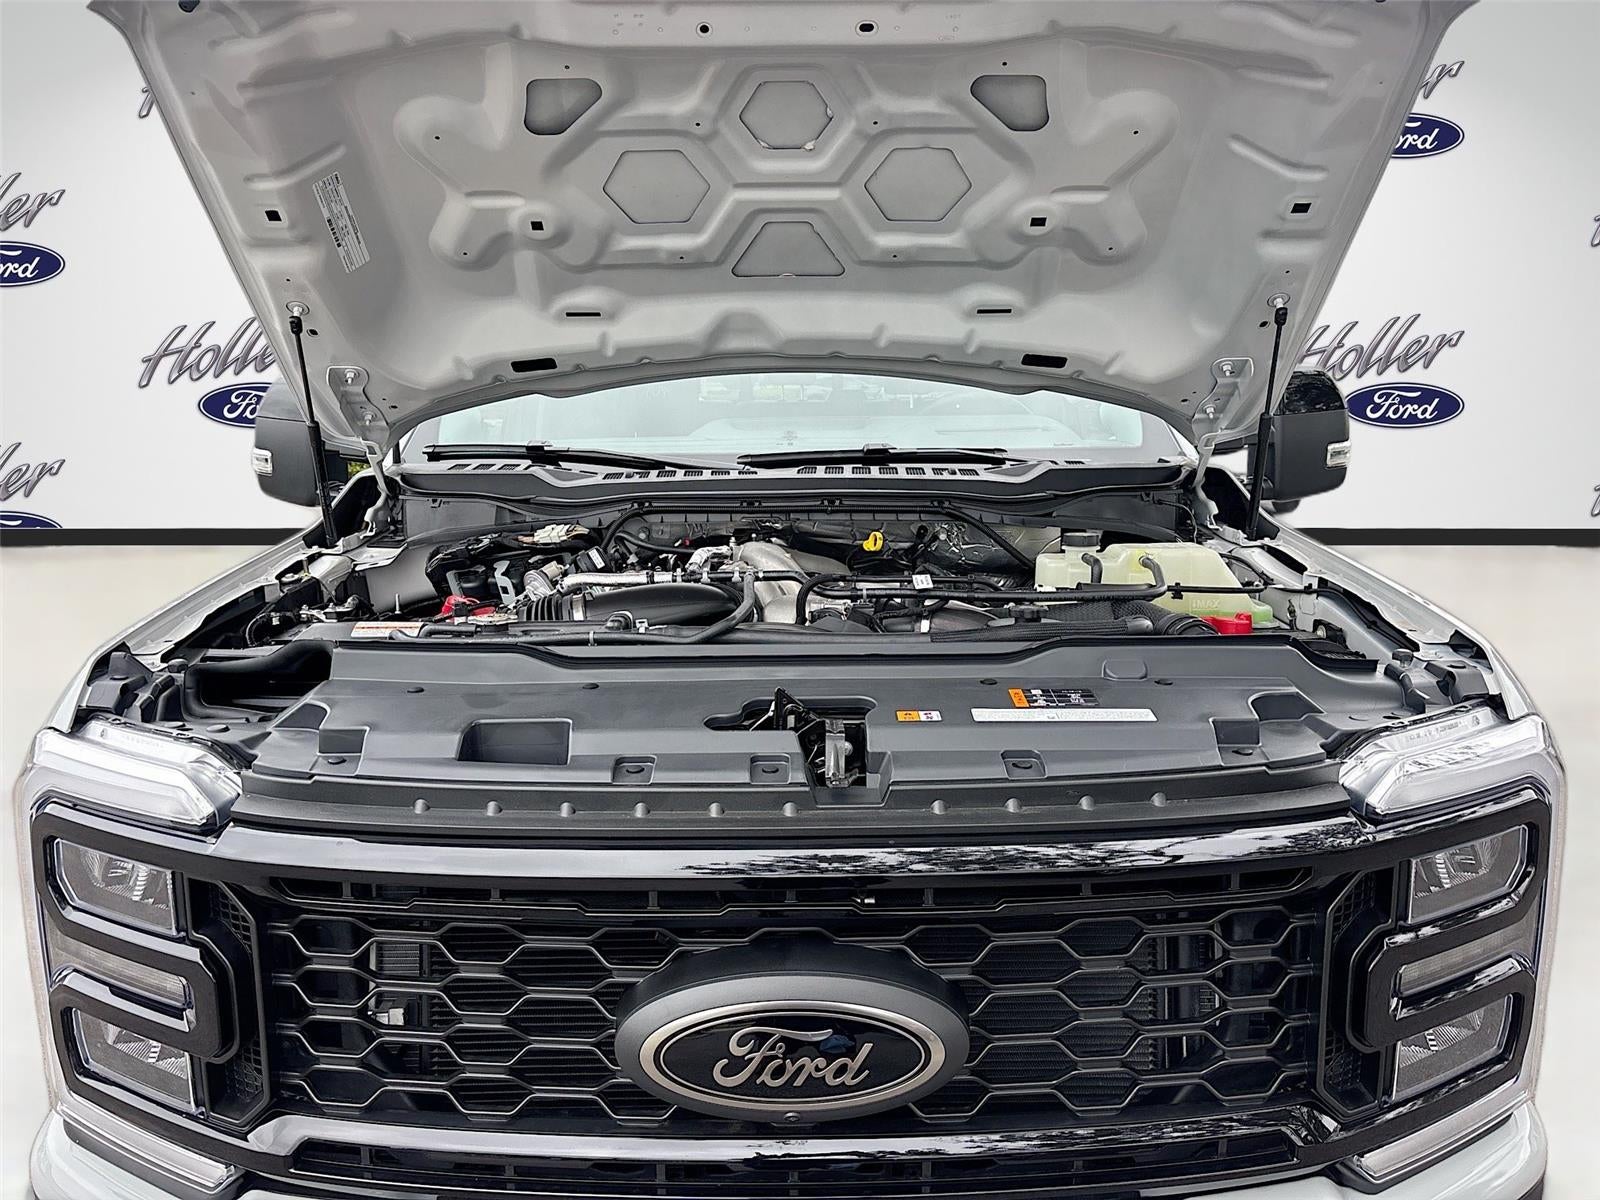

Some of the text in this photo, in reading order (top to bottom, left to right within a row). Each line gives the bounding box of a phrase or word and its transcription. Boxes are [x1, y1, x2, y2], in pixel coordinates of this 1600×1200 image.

[1298, 313, 1465, 381] Holler
[223, 390, 267, 419] Fo
[1366, 389, 1440, 419] Ford
[712, 1026, 874, 1088] Ford
